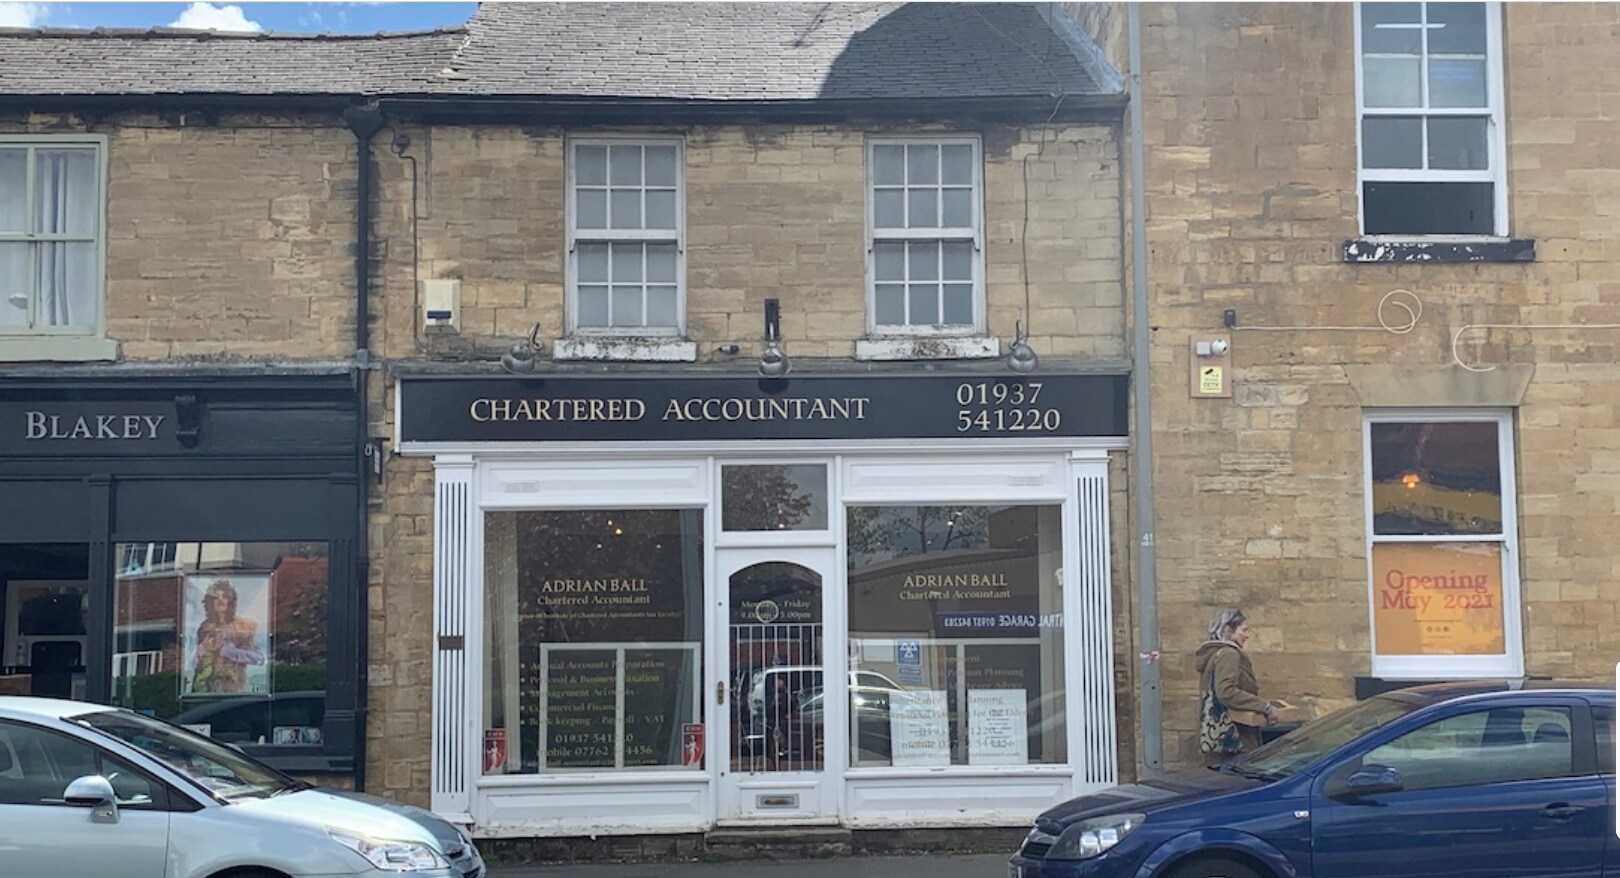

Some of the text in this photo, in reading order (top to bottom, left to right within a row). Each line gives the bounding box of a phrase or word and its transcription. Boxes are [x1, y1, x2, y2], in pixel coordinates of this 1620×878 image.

[956, 383, 1043, 406] 01937
[470, 397, 870, 421] CHARTERED ACCOUNTANT
[956, 408, 1062, 431] 541220
[541, 579, 648, 593] ADRIAN BALL
[904, 574, 1008, 588] ADRIAN BALL
[1385, 569, 1489, 593] Opening
[537, 595, 650, 606] Chartered Accountant
[900, 589, 1011, 600] Chartered Accountant
[1381, 589, 1495, 615] May 2021
[567, 661, 609, 670] Accounts
[644, 715, 666, 724] VAT
[575, 746, 609, 756] 07762
